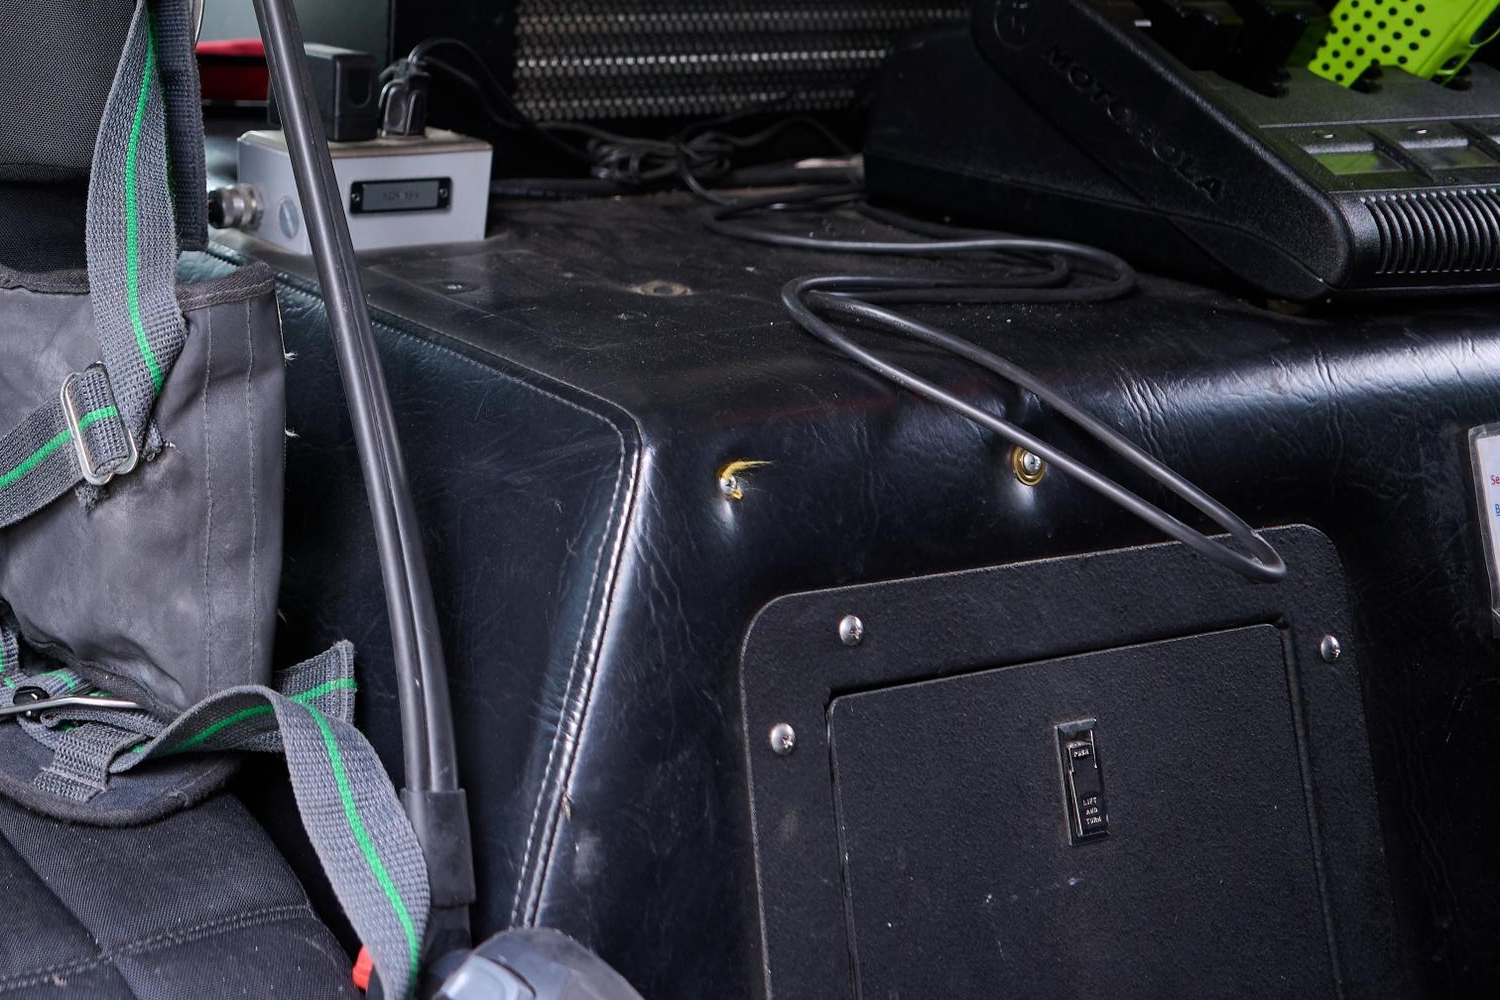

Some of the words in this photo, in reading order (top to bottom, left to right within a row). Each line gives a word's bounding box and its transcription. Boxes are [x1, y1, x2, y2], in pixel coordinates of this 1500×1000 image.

[1043, 44, 1221, 203] MOTOROLA
[1073, 750, 1090, 758] PUSH
[1082, 797, 1097, 806] LIFT
[1086, 807, 1098, 815] AND
[1086, 816, 1102, 825] TURN
